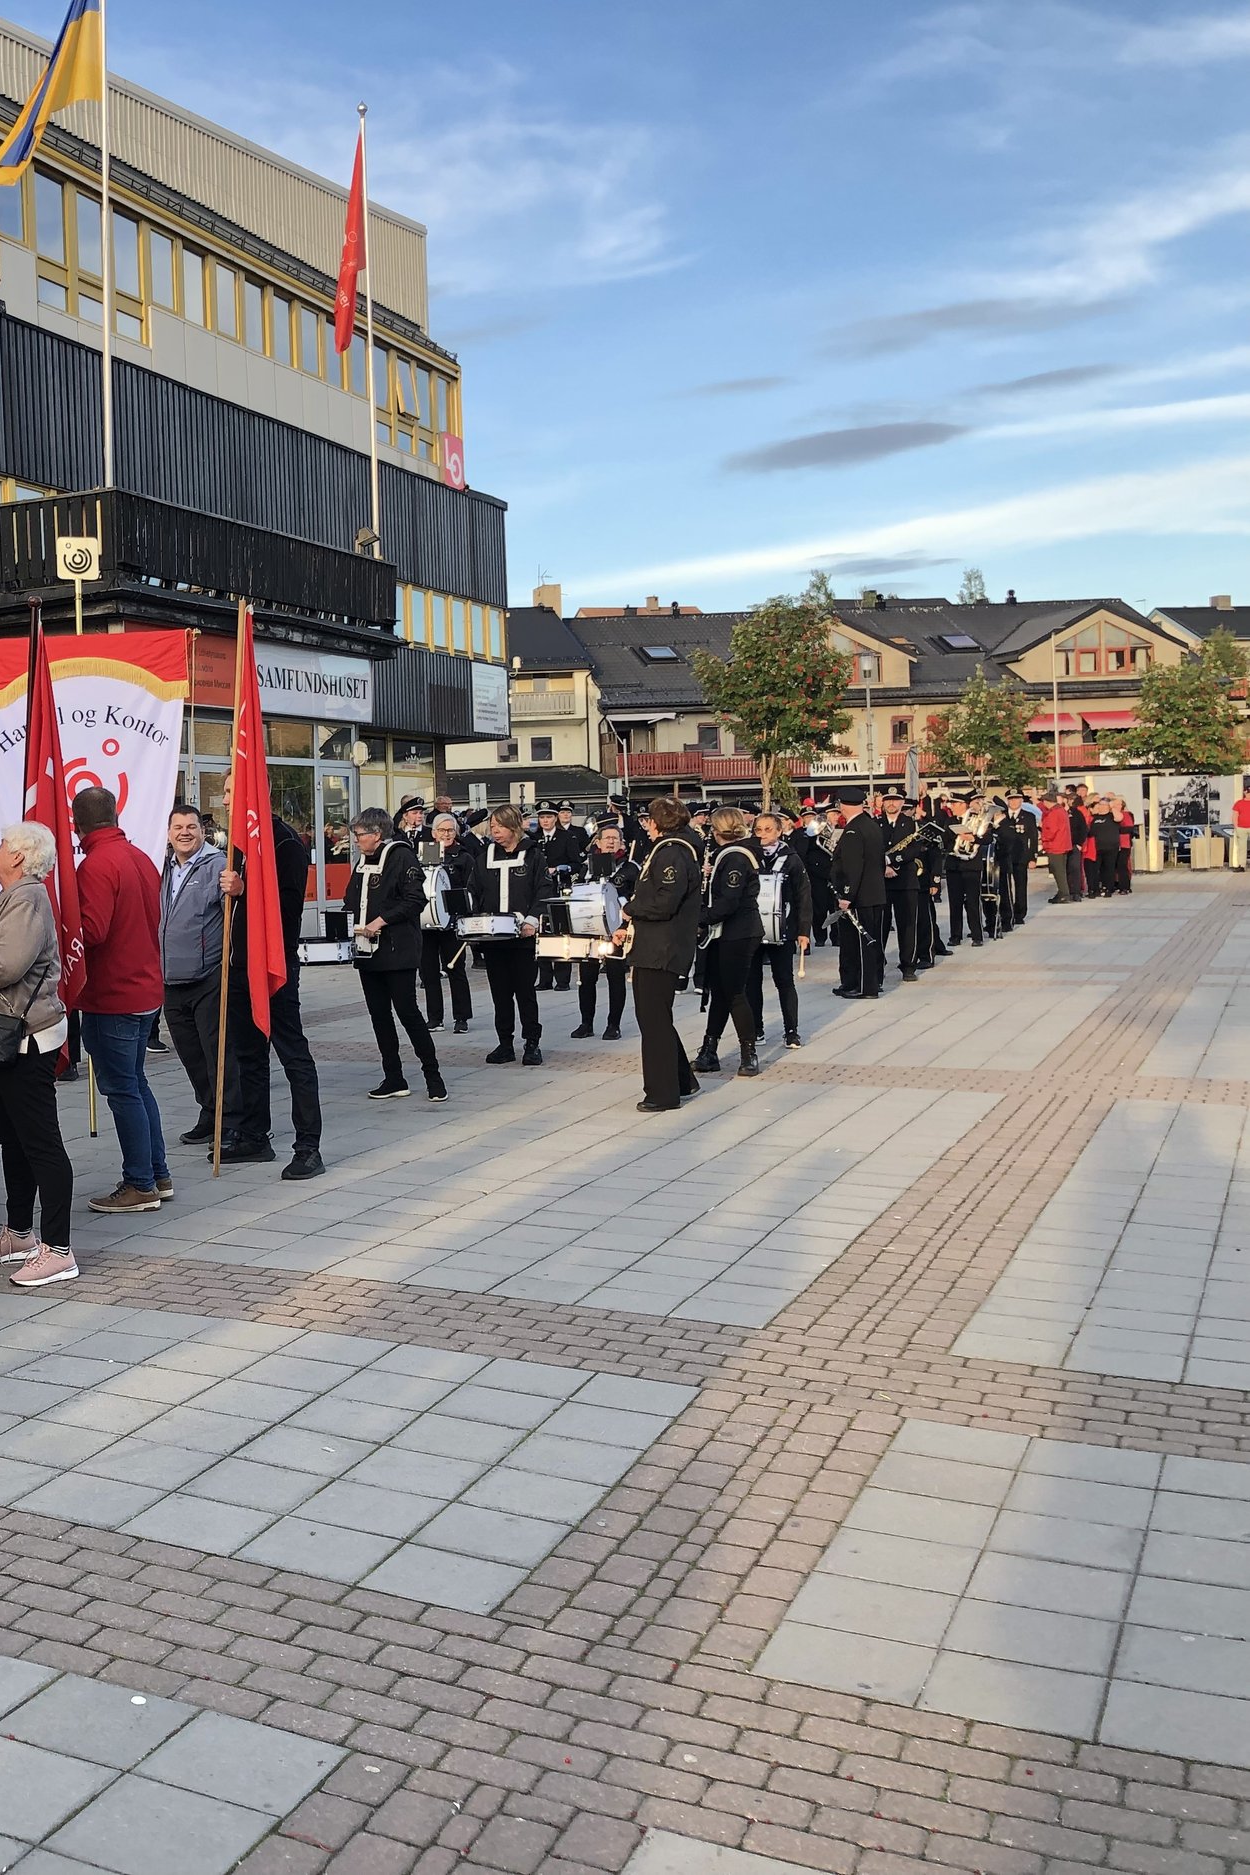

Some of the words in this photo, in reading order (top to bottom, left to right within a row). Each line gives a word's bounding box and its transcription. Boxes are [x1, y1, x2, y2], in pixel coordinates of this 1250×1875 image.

[256, 664, 369, 700] SAMFUNDSHUSET
[71, 709, 97, 728] og
[104, 705, 169, 747] Kontor
